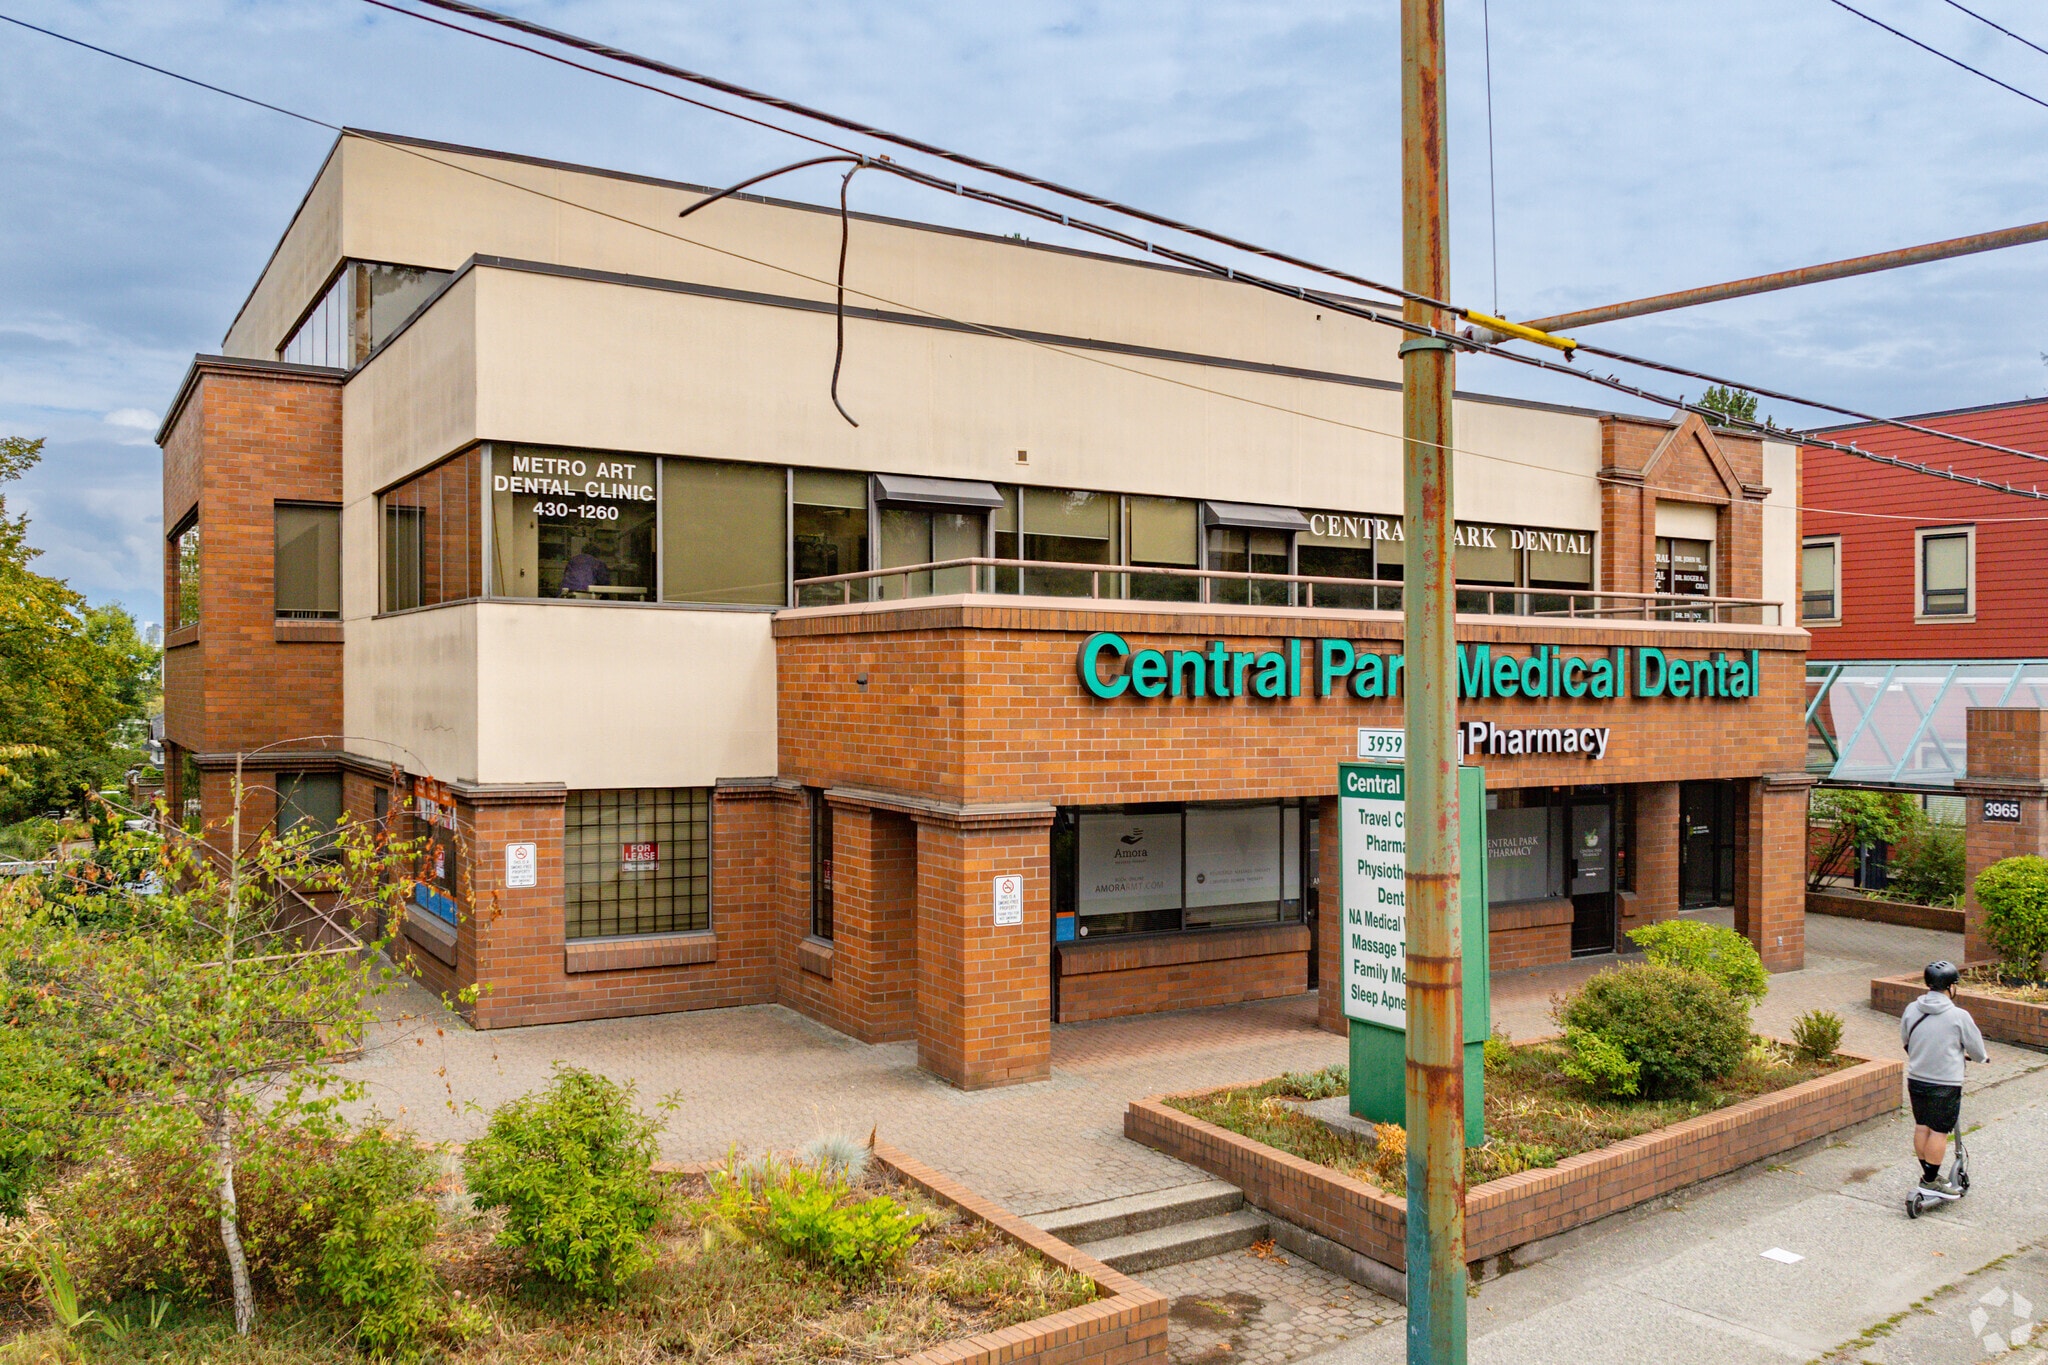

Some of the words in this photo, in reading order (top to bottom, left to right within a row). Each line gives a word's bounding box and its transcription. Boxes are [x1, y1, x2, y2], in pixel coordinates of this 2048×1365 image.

[512, 456, 586, 476] METRO
[596, 462, 636, 480] ART
[494, 475, 576, 496] DENTAL
[585, 481, 654, 501] CLINIC
[533, 502, 619, 520] 430-1260
[1310, 514, 1404, 542] CENTRA
[1454, 526, 1497, 548] ARK
[1510, 529, 1591, 554] DENTAL
[1081, 632, 1300, 699] Central
[1321, 638, 1404, 698] Par
[1456, 644, 1625, 698] Medical
[1639, 647, 1759, 698] Dental
[1368, 736, 1402, 752] 3959
[1468, 722, 1610, 760] Pharmacy
[1346, 772, 1400, 794] Central
[1358, 808, 1391, 827] Travel
[1985, 802, 2019, 818] 3965
[1488, 838, 1518, 848] ENTRAL
[1519, 836, 1538, 846] PARK
[1488, 846, 1532, 858] PHARMACY
[625, 852, 656, 861] LEASE
[1114, 849, 1148, 858] Amora
[1358, 859, 1404, 880] Physioth
[1378, 887, 1405, 906] Dent
[1349, 908, 1362, 926] NA
[1364, 910, 1400, 931] Medical
[1352, 933, 1397, 959] Massage
[1354, 959, 1388, 984] Family
[1351, 984, 1378, 1007] Sleep
[1381, 990, 1406, 1011] Apne
